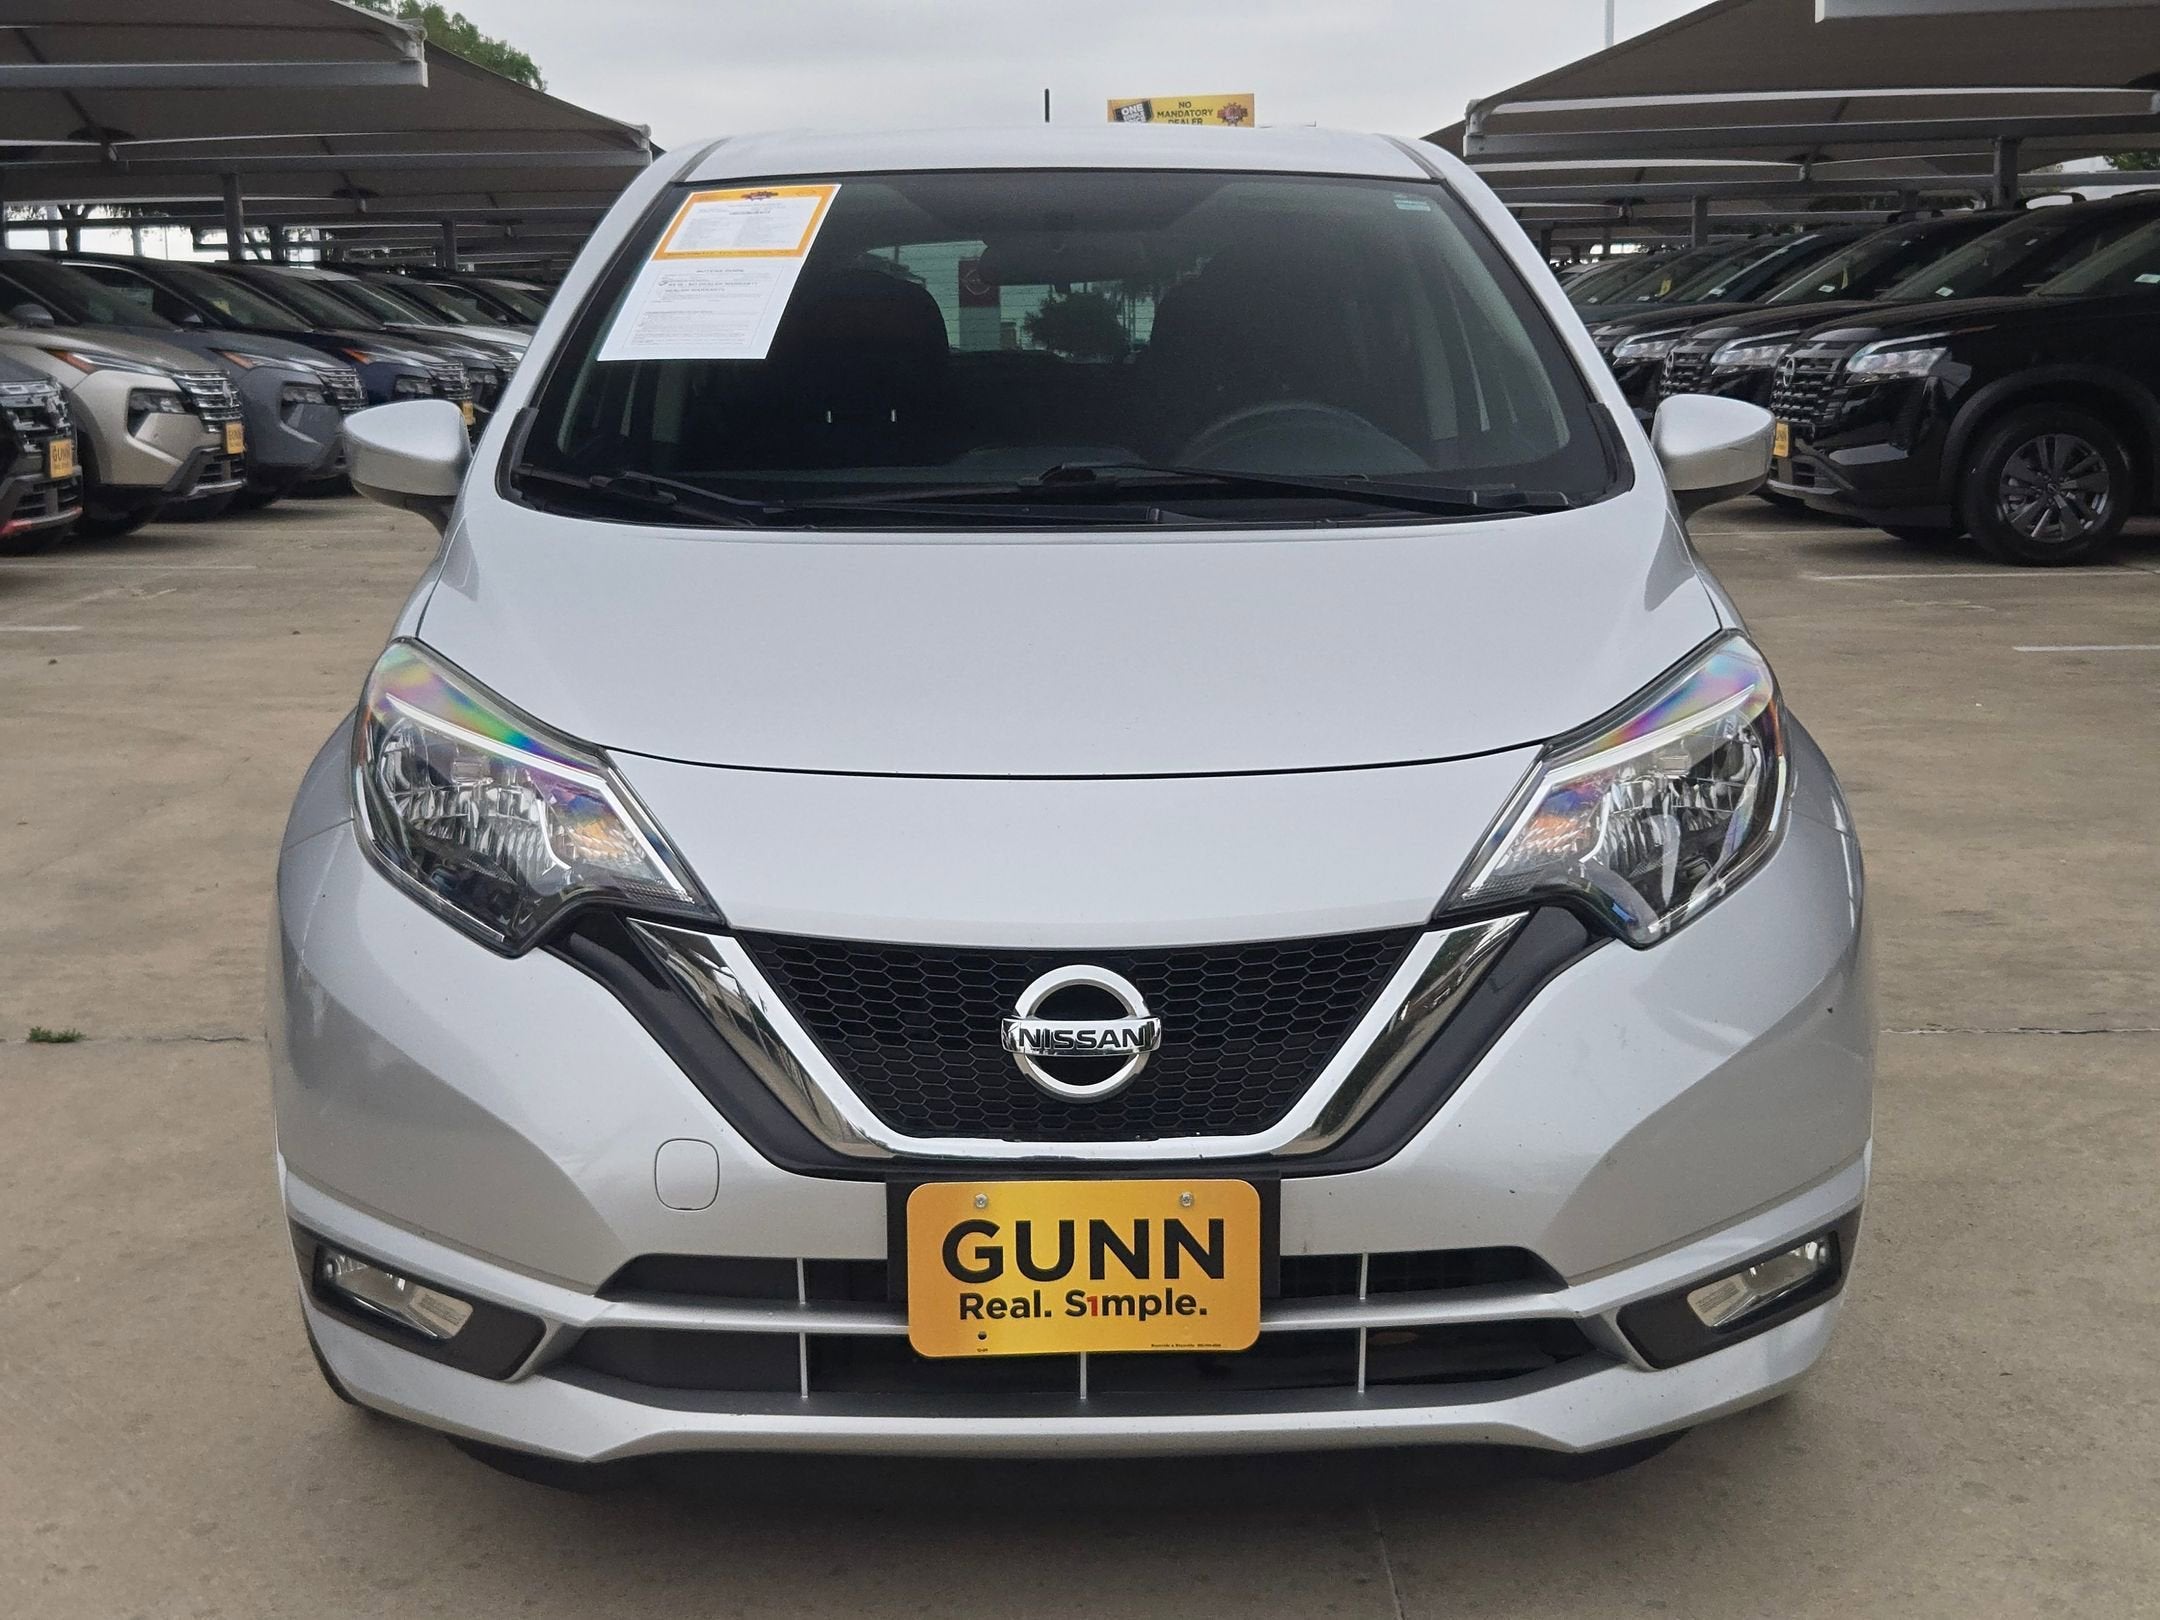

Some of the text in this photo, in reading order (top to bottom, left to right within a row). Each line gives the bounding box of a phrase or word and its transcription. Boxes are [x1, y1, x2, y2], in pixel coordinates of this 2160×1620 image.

[1121, 103, 1144, 115] ONE
[1179, 101, 1192, 109] NO
[1157, 109, 1213, 118] MANDATORY
[1018, 1028, 1145, 1049] NISSAN
[942, 1218, 1225, 1284] GUNN
[959, 1289, 1053, 1320] Real.
